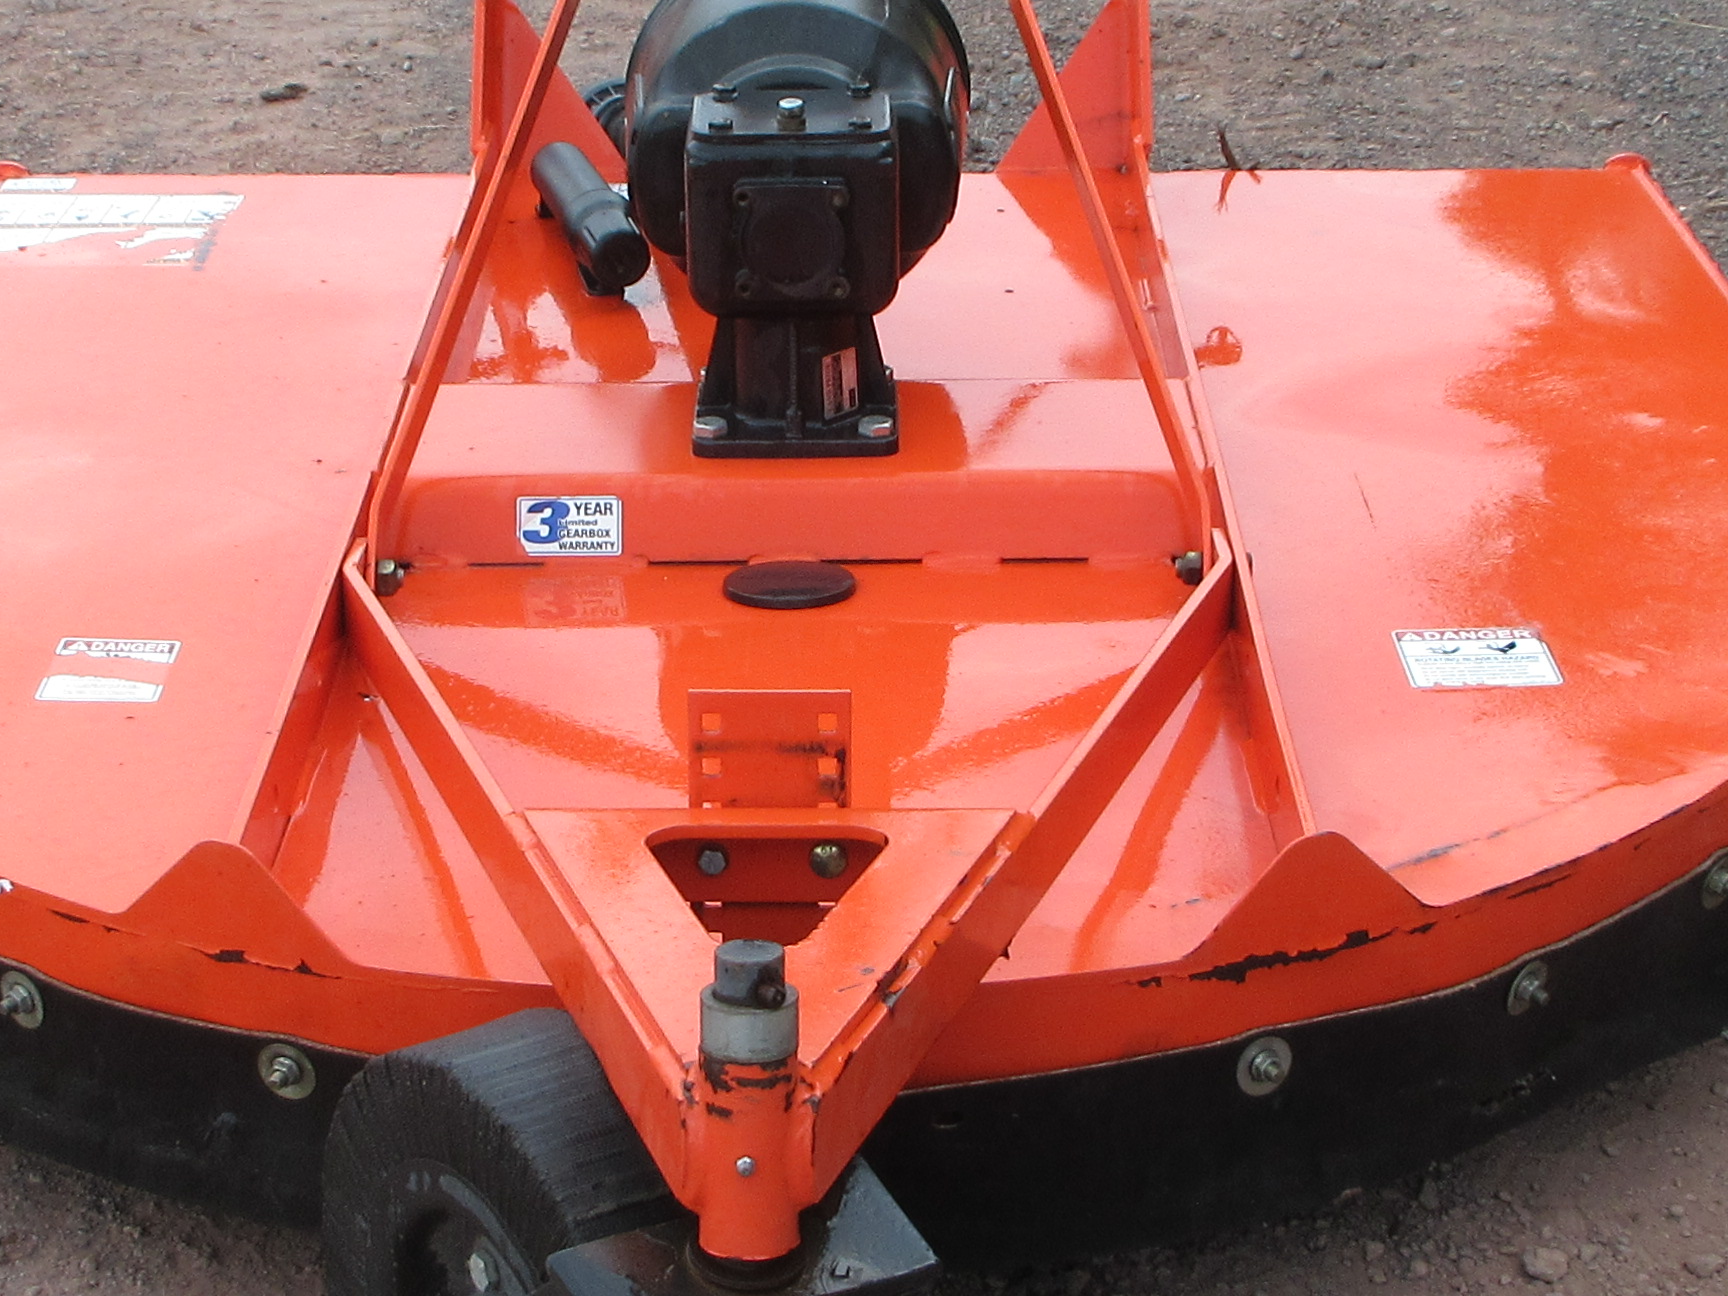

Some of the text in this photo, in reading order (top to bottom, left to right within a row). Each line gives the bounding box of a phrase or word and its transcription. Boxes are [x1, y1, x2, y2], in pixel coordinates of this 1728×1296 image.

[522, 500, 614, 544] 3 YEAR
[558, 518, 598, 527] Limited
[558, 528, 612, 539] GEARBOX
[558, 540, 616, 551] WARRANTY
[1423, 629, 1532, 641] DANGER
[90, 641, 170, 653] DANGER
